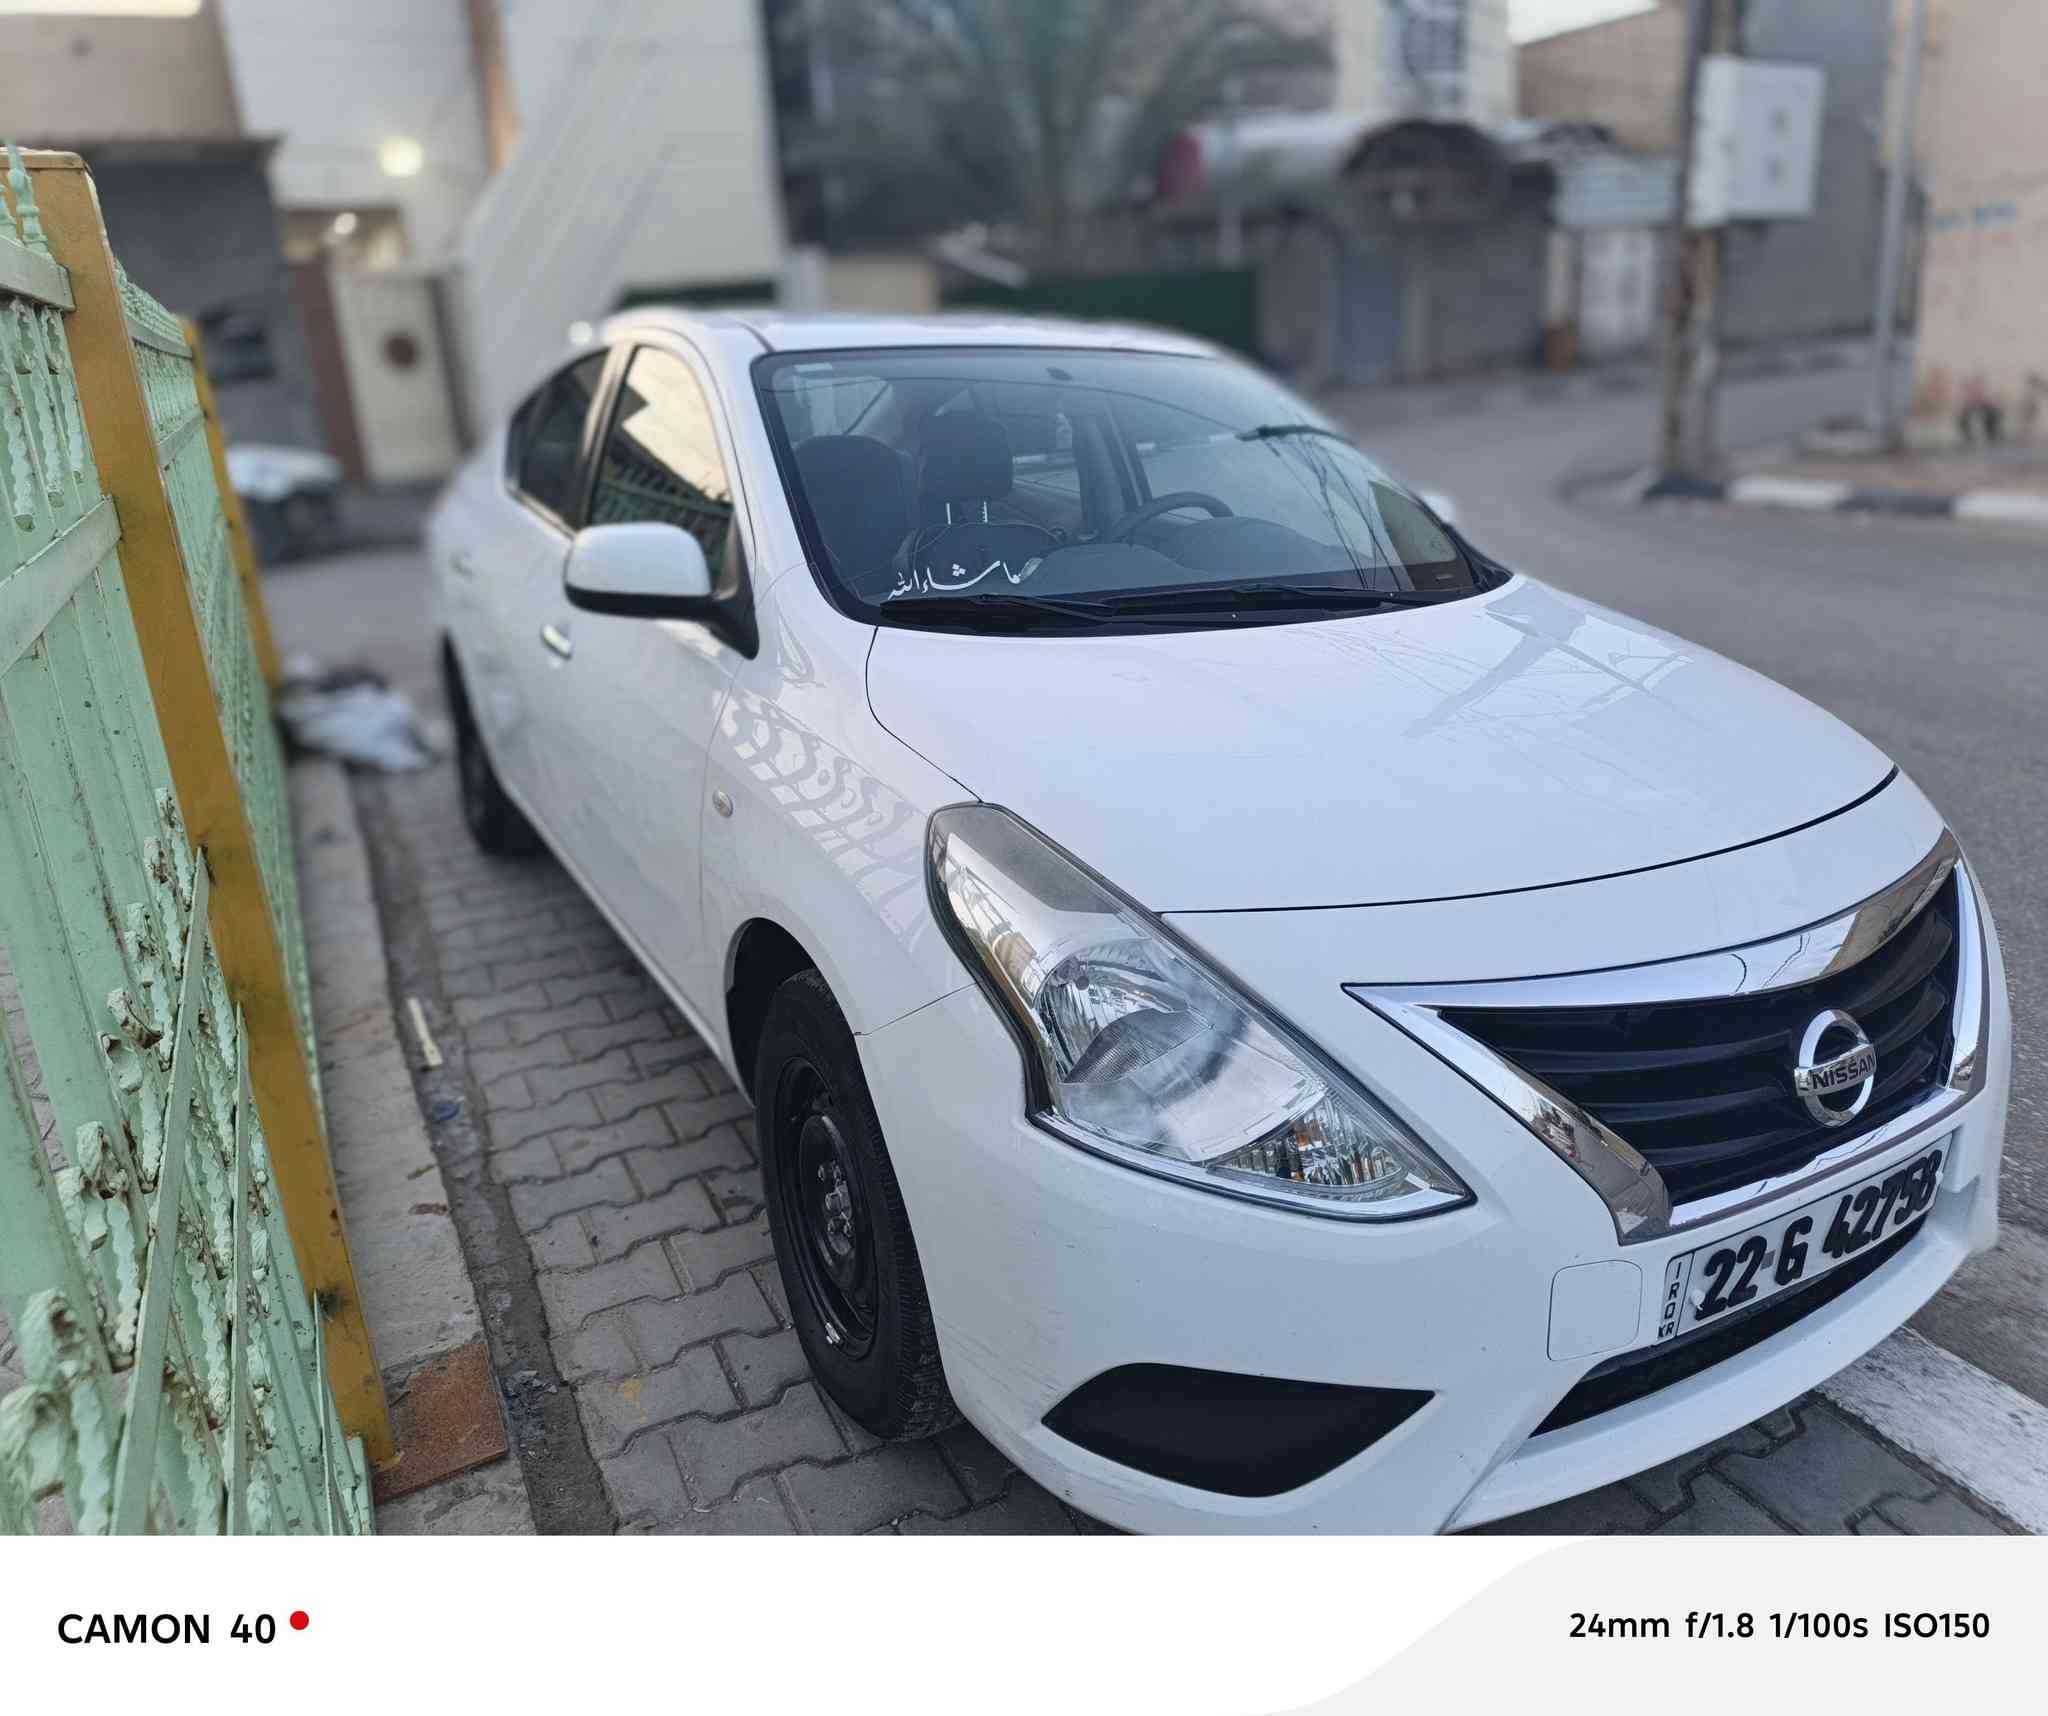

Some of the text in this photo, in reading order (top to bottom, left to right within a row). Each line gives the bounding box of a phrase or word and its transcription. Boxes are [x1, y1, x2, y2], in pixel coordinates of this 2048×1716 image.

[1811, 1053, 1877, 1090] NISSAN
[1694, 1235, 1768, 1321] 22
[1822, 1149, 1943, 1259] 42758
[1658, 1321, 1675, 1338] KR
